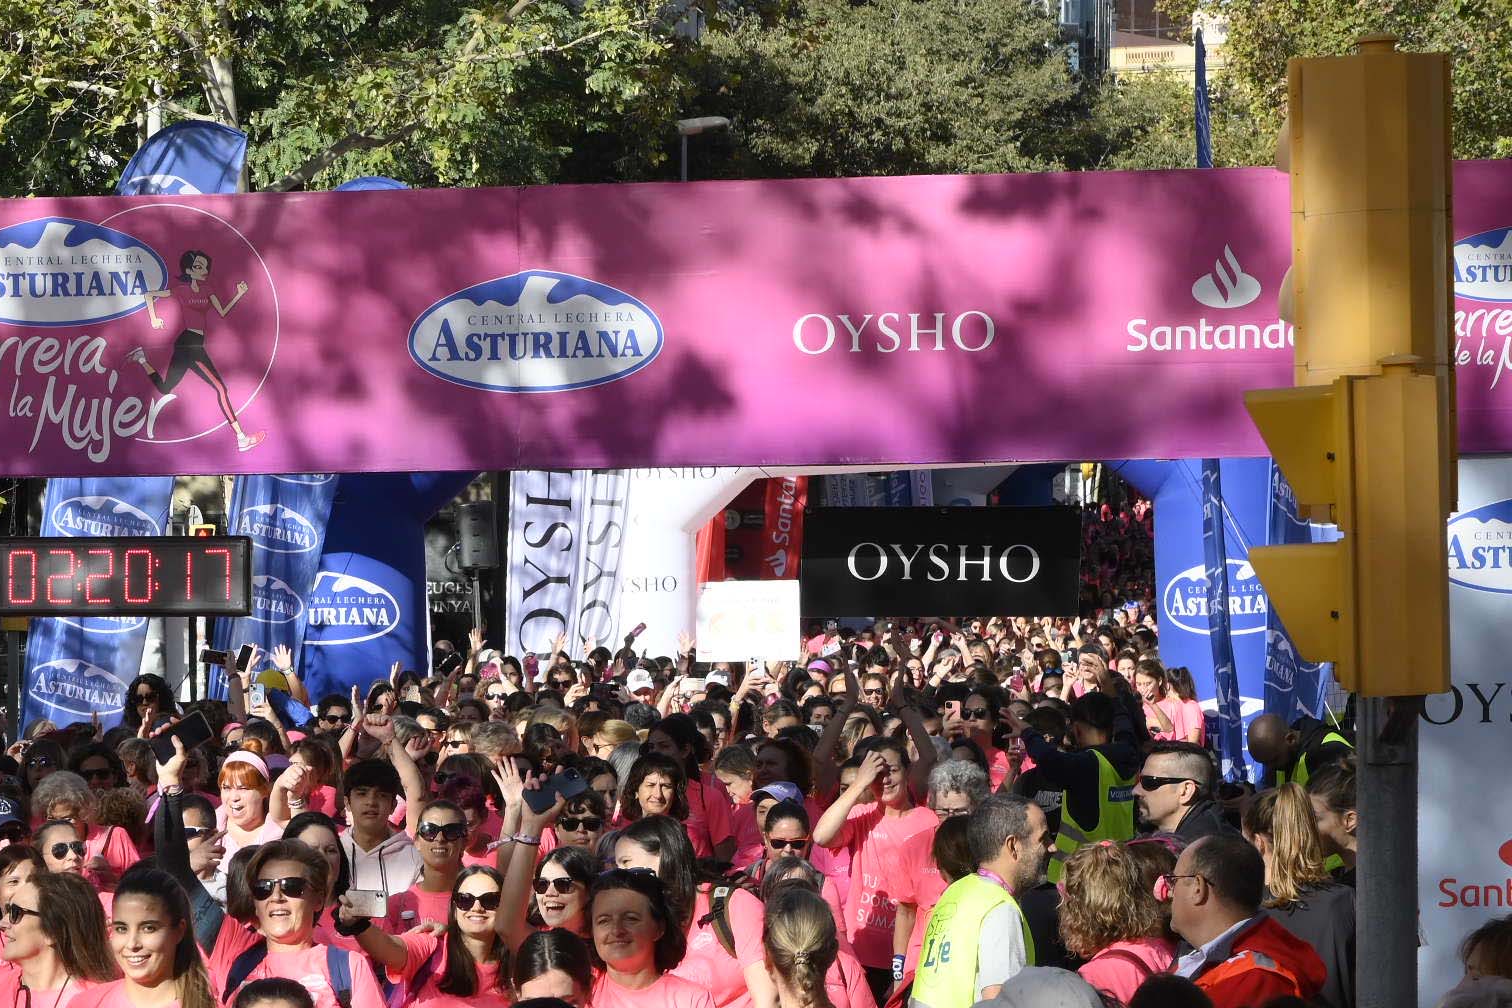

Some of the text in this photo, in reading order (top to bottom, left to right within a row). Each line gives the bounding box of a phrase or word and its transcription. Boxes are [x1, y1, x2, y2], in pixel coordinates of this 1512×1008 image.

[71, 255, 144, 265] LECHERA
[468, 311, 636, 327] CENTRAL LECHERA
[792, 310, 996, 355] OYSHO
[428, 318, 644, 361] ASTURIANA
[9, 379, 33, 418] la
[29, 369, 177, 463] Mujer
[240, 514, 311, 548] ASTURIANA
[8, 548, 232, 604] 02:20:17
[847, 542, 1041, 584] OYSHO
[32, 673, 123, 708] ASTURIANA
[862, 874, 879, 889] TU
